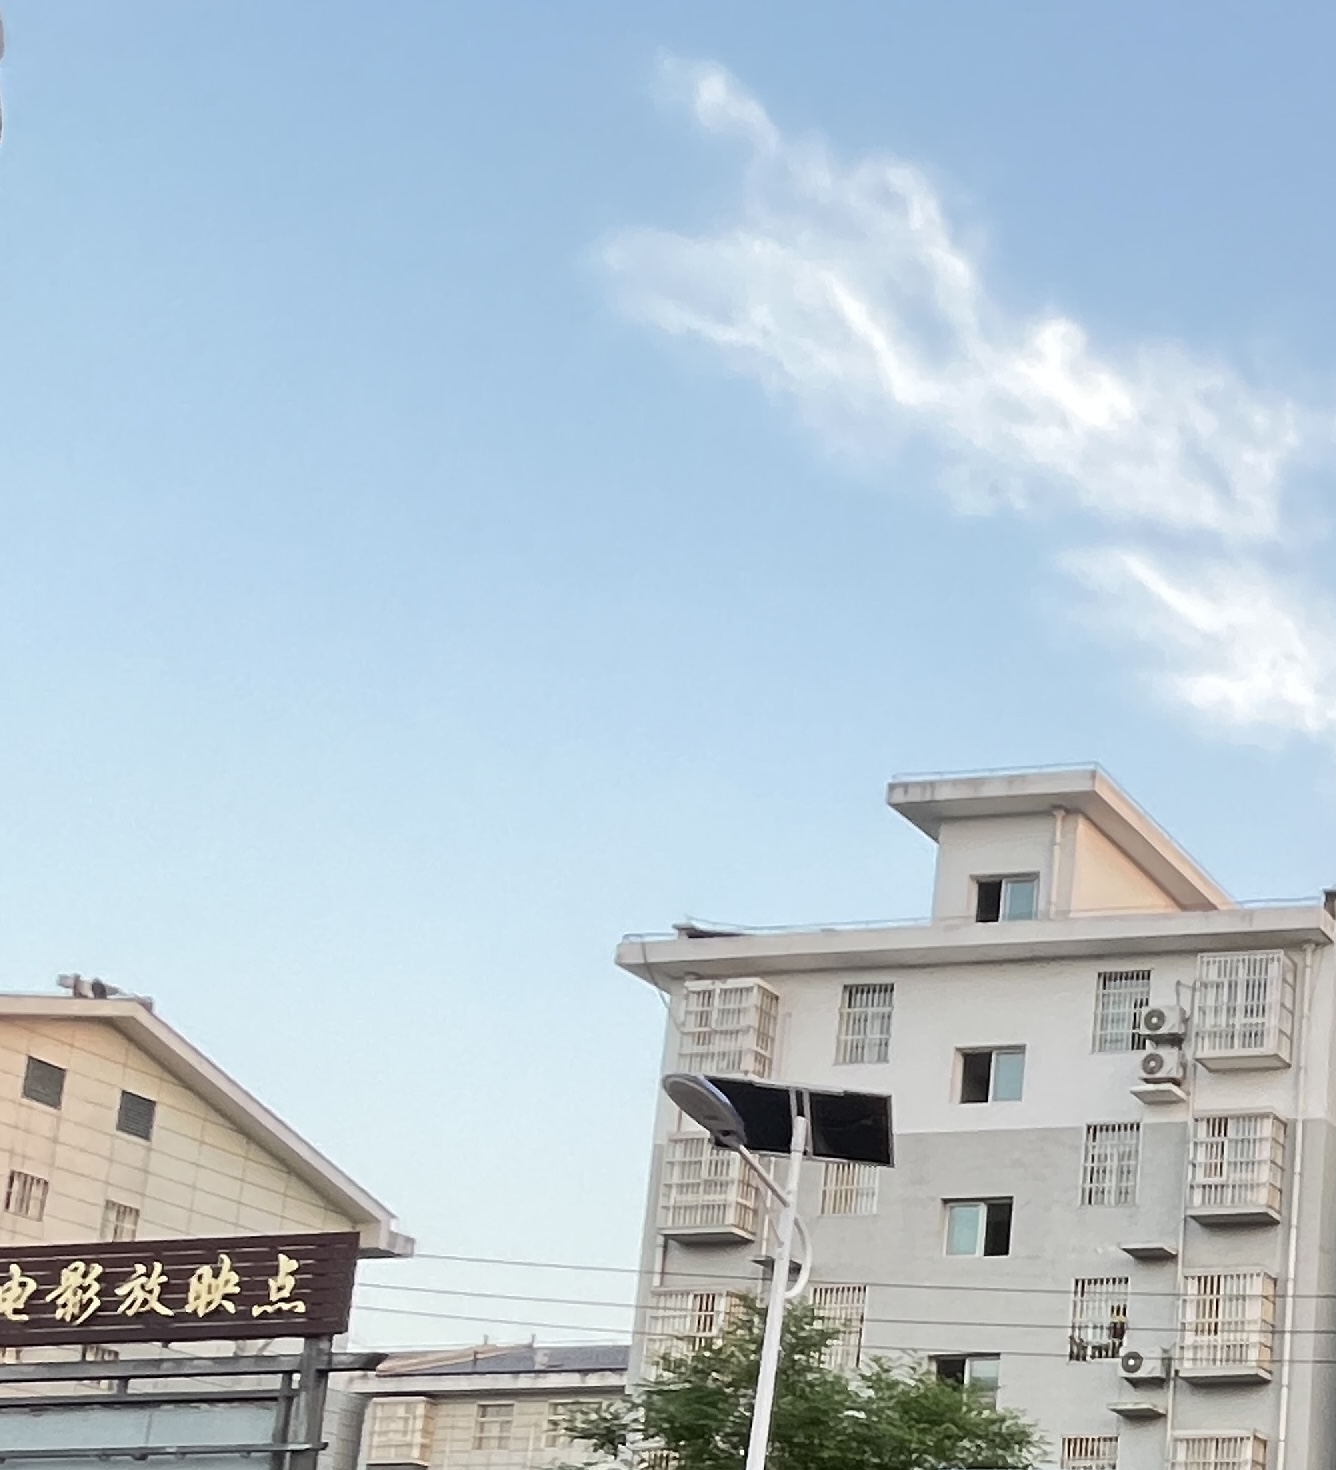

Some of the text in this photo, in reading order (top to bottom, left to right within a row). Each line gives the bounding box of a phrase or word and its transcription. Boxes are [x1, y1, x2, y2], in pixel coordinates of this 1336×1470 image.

[0, 1254, 306, 1325] 电影放映点
